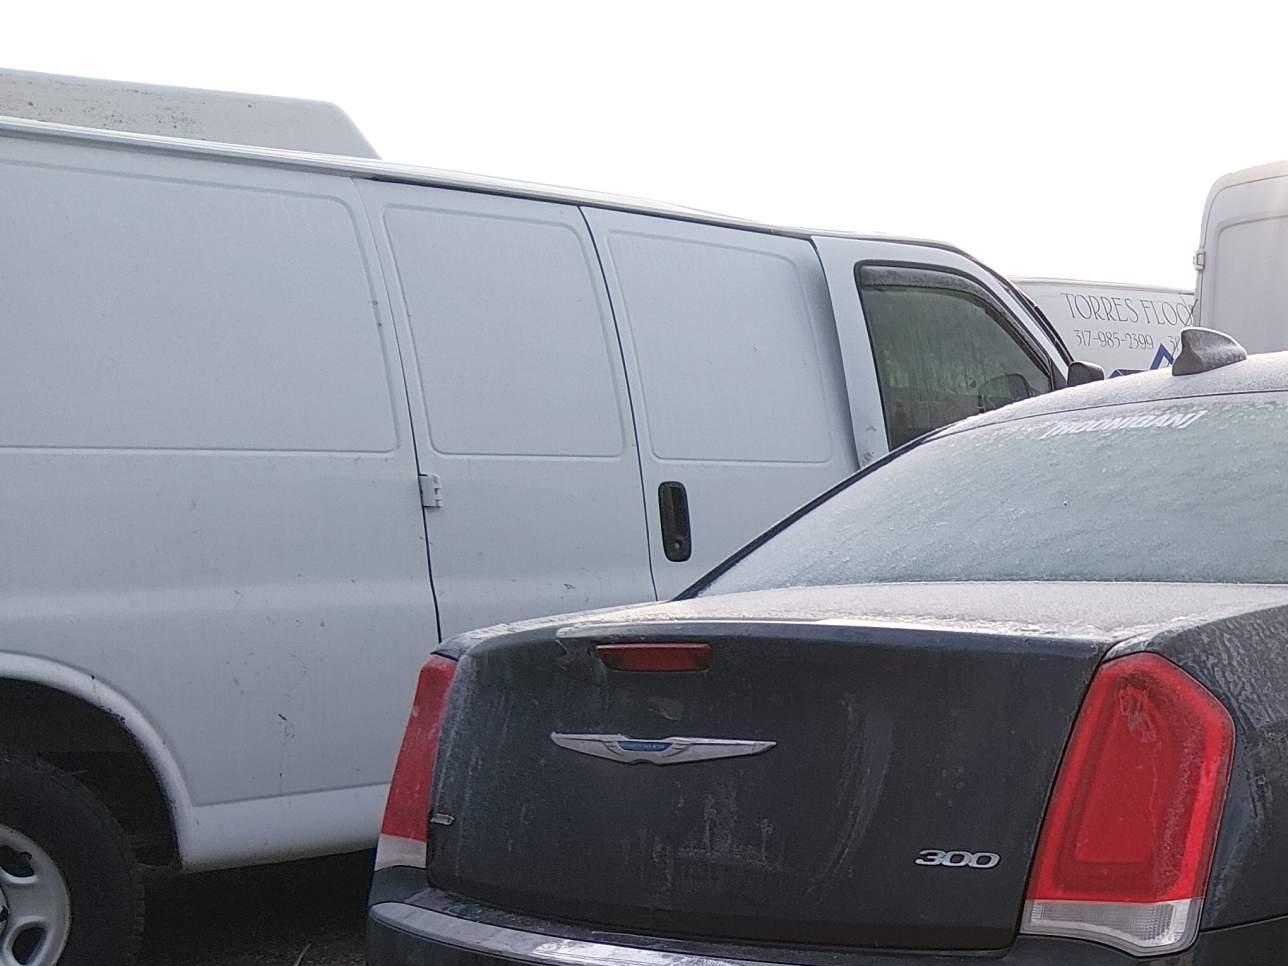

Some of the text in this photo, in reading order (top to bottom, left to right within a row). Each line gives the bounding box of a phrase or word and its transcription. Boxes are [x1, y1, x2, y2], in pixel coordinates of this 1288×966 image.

[1060, 292, 1195, 327] TORRES FLOO
[1073, 329, 1154, 350] 317-985-2399
[915, 849, 1000, 868] 300
